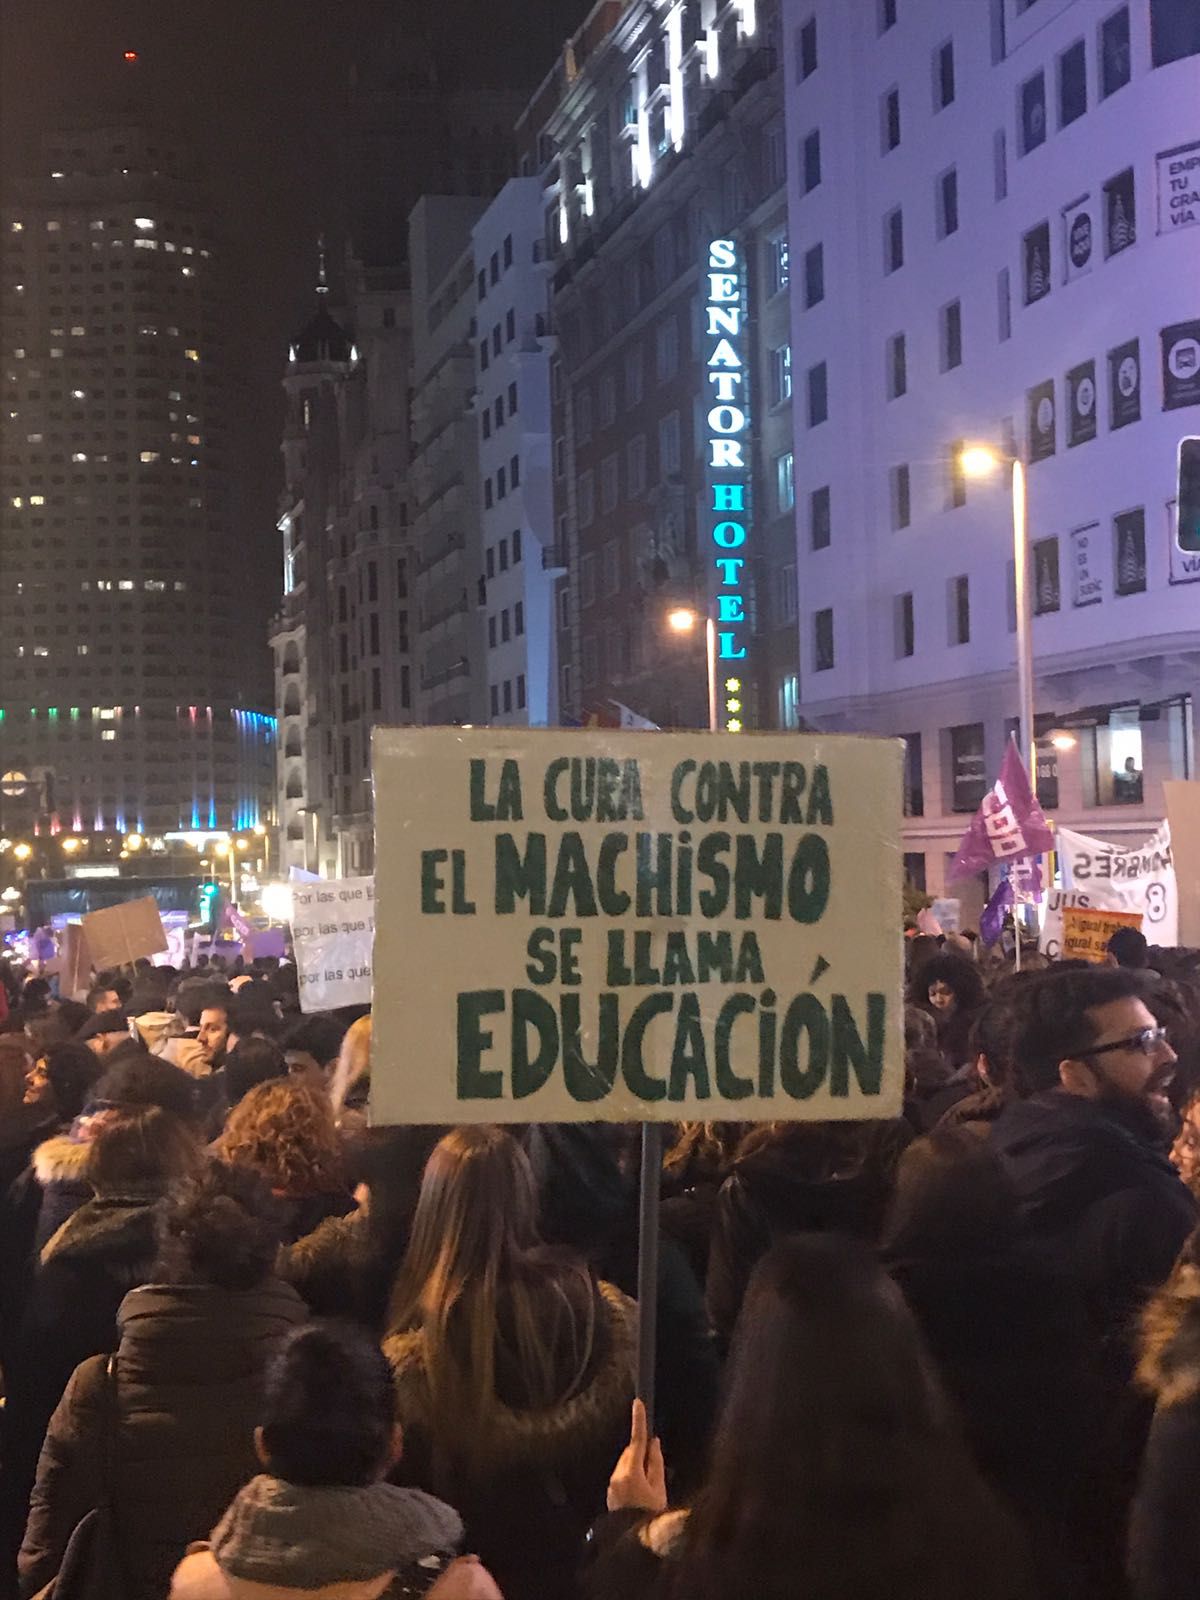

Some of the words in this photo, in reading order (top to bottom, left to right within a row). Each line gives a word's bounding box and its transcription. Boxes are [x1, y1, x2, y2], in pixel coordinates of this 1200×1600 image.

[1169, 176, 1188, 192] TU
[706, 239, 745, 467] SENATOR
[712, 485, 746, 660] HOTEL
[469, 758, 523, 822] LA
[543, 757, 645, 823] CURA
[671, 759, 834, 825] CONTRA
[317, 891, 335, 902] las
[339, 889, 362, 902] que
[420, 849, 476, 915] EL
[320, 923, 338, 935] las
[341, 921, 365, 934] que
[525, 927, 582, 986] SE
[606, 929, 765, 987] LLAMA
[299, 972, 320, 986] por
[324, 968, 343, 981] las
[348, 966, 371, 979] que
